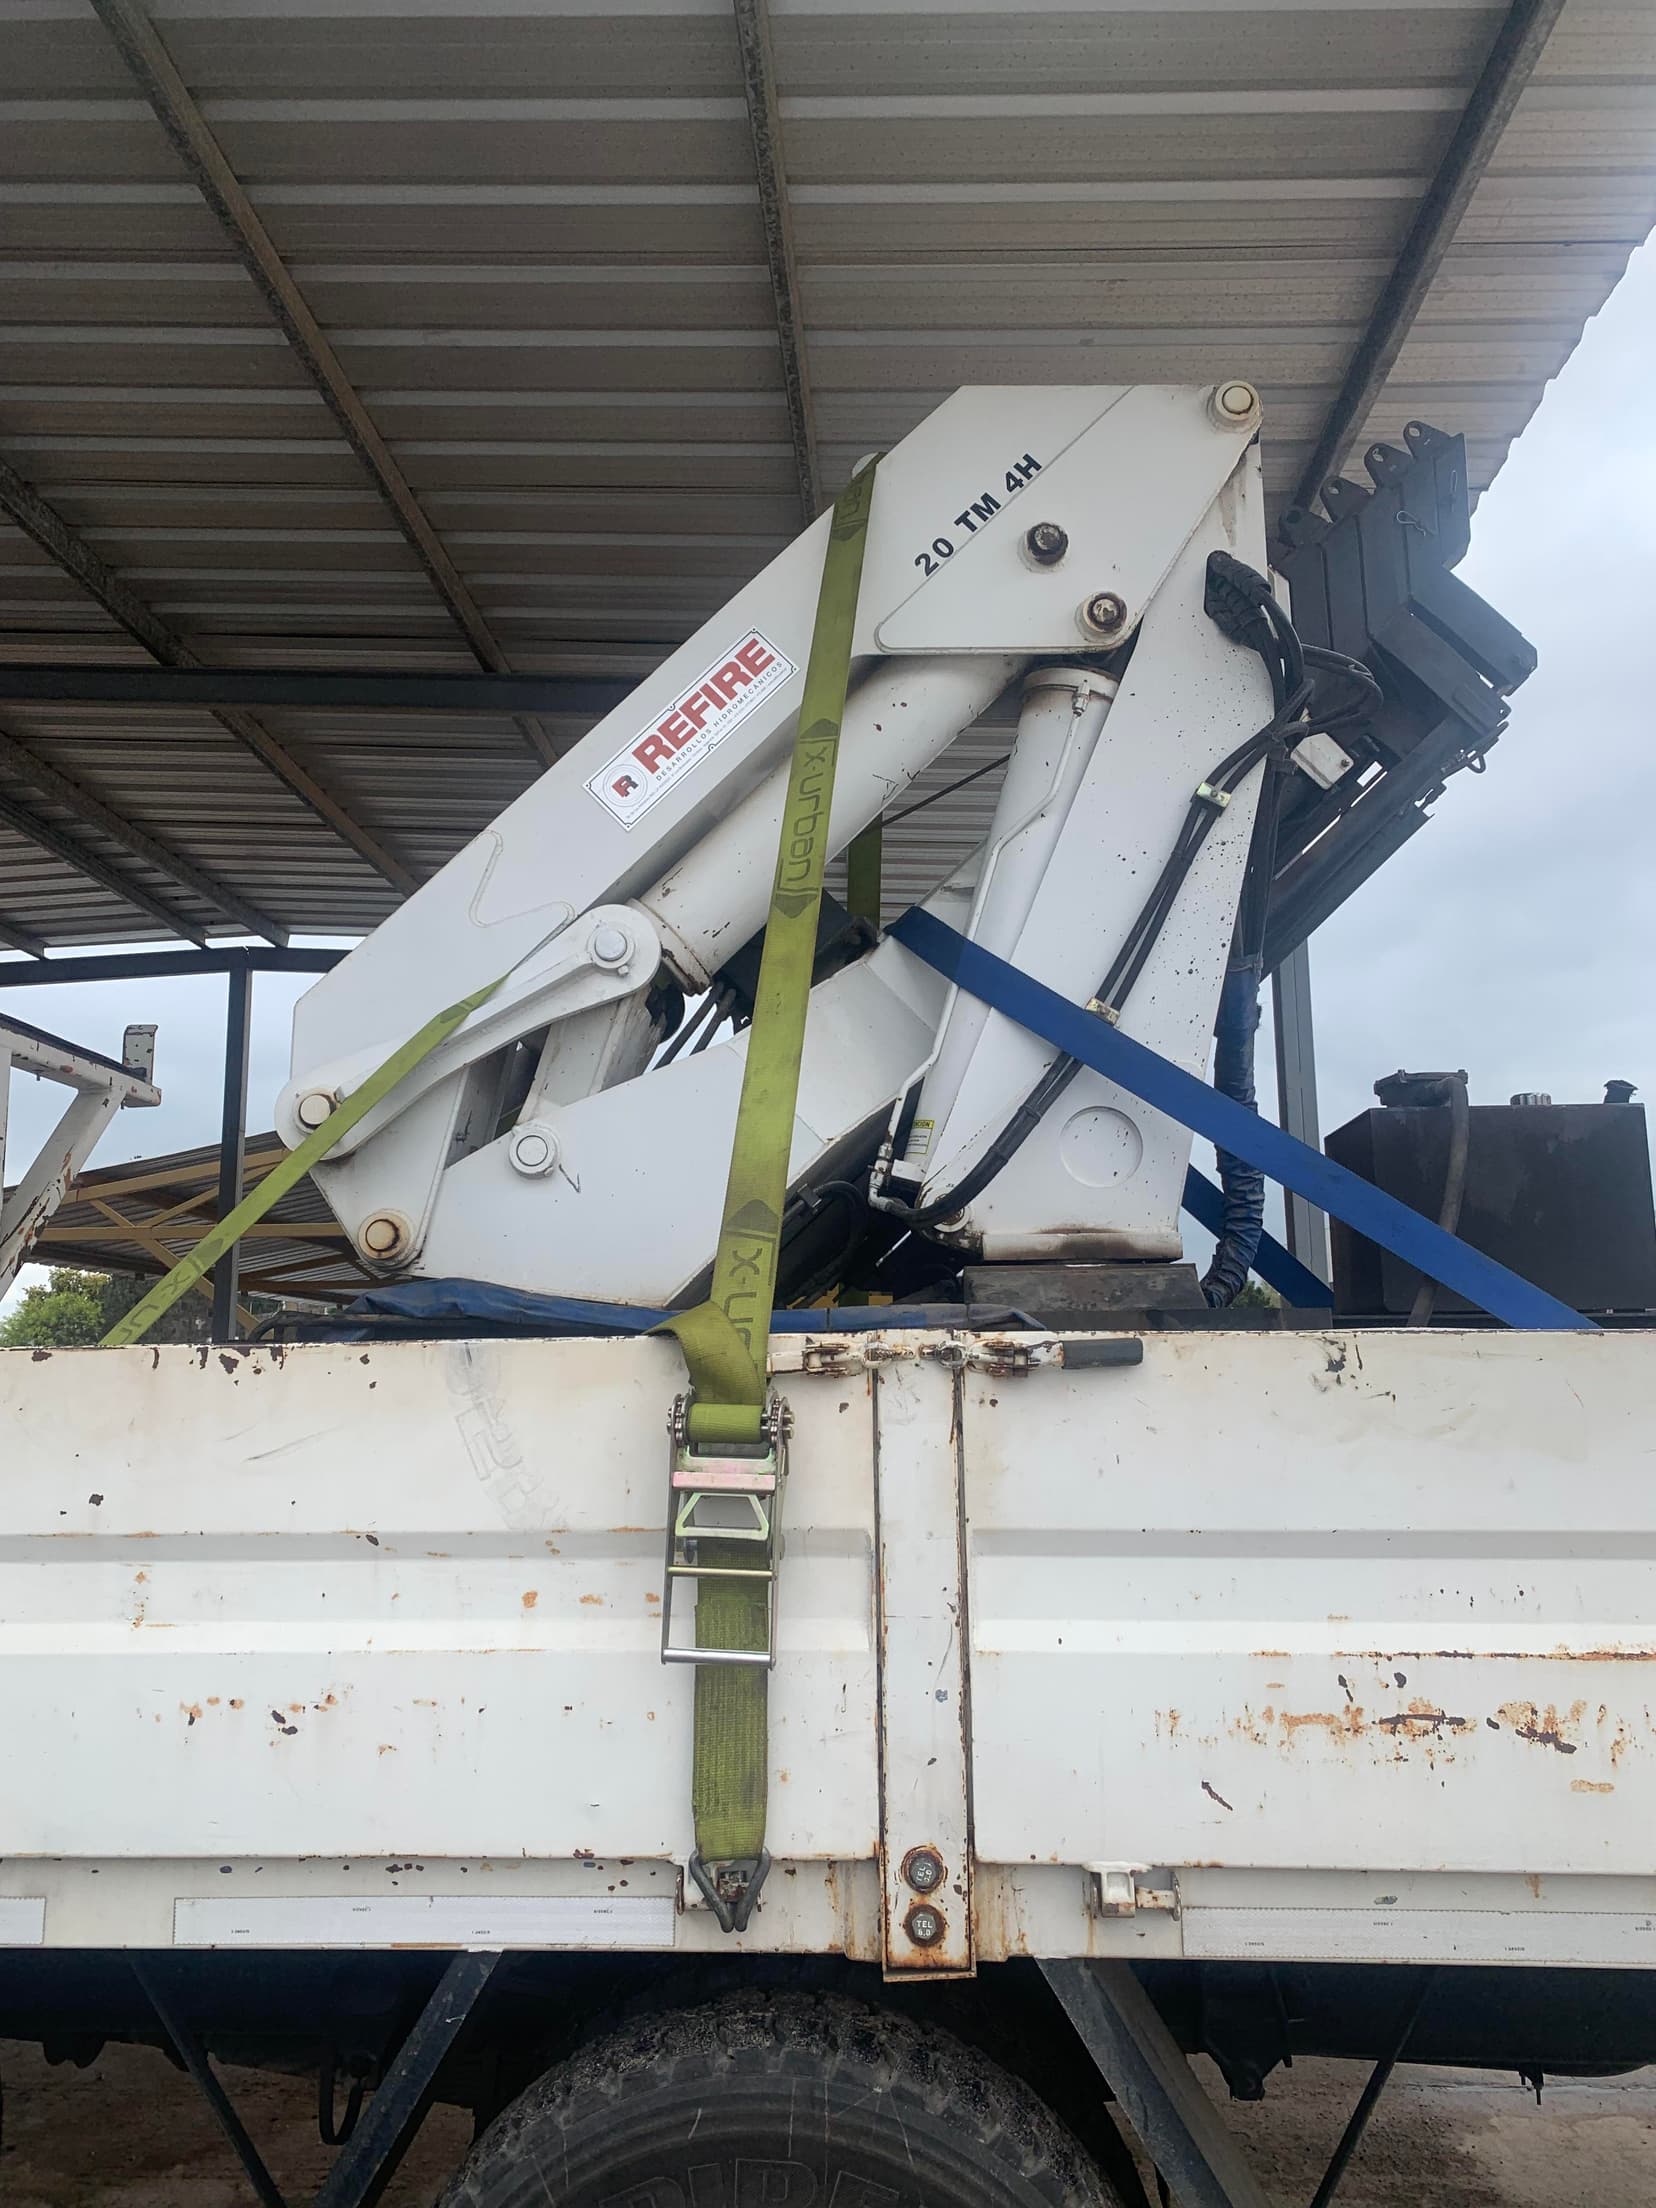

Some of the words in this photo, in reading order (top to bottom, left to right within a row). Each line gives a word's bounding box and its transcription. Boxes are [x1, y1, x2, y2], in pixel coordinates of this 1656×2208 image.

[914, 537, 954, 577] 20
[953, 492, 1002, 533] TM
[1005, 453, 1042, 493] 4H
[631, 637, 776, 774] REFIRE
[655, 728, 712, 781] DESARROLLOS
[916, 1920, 933, 1929] TEL
